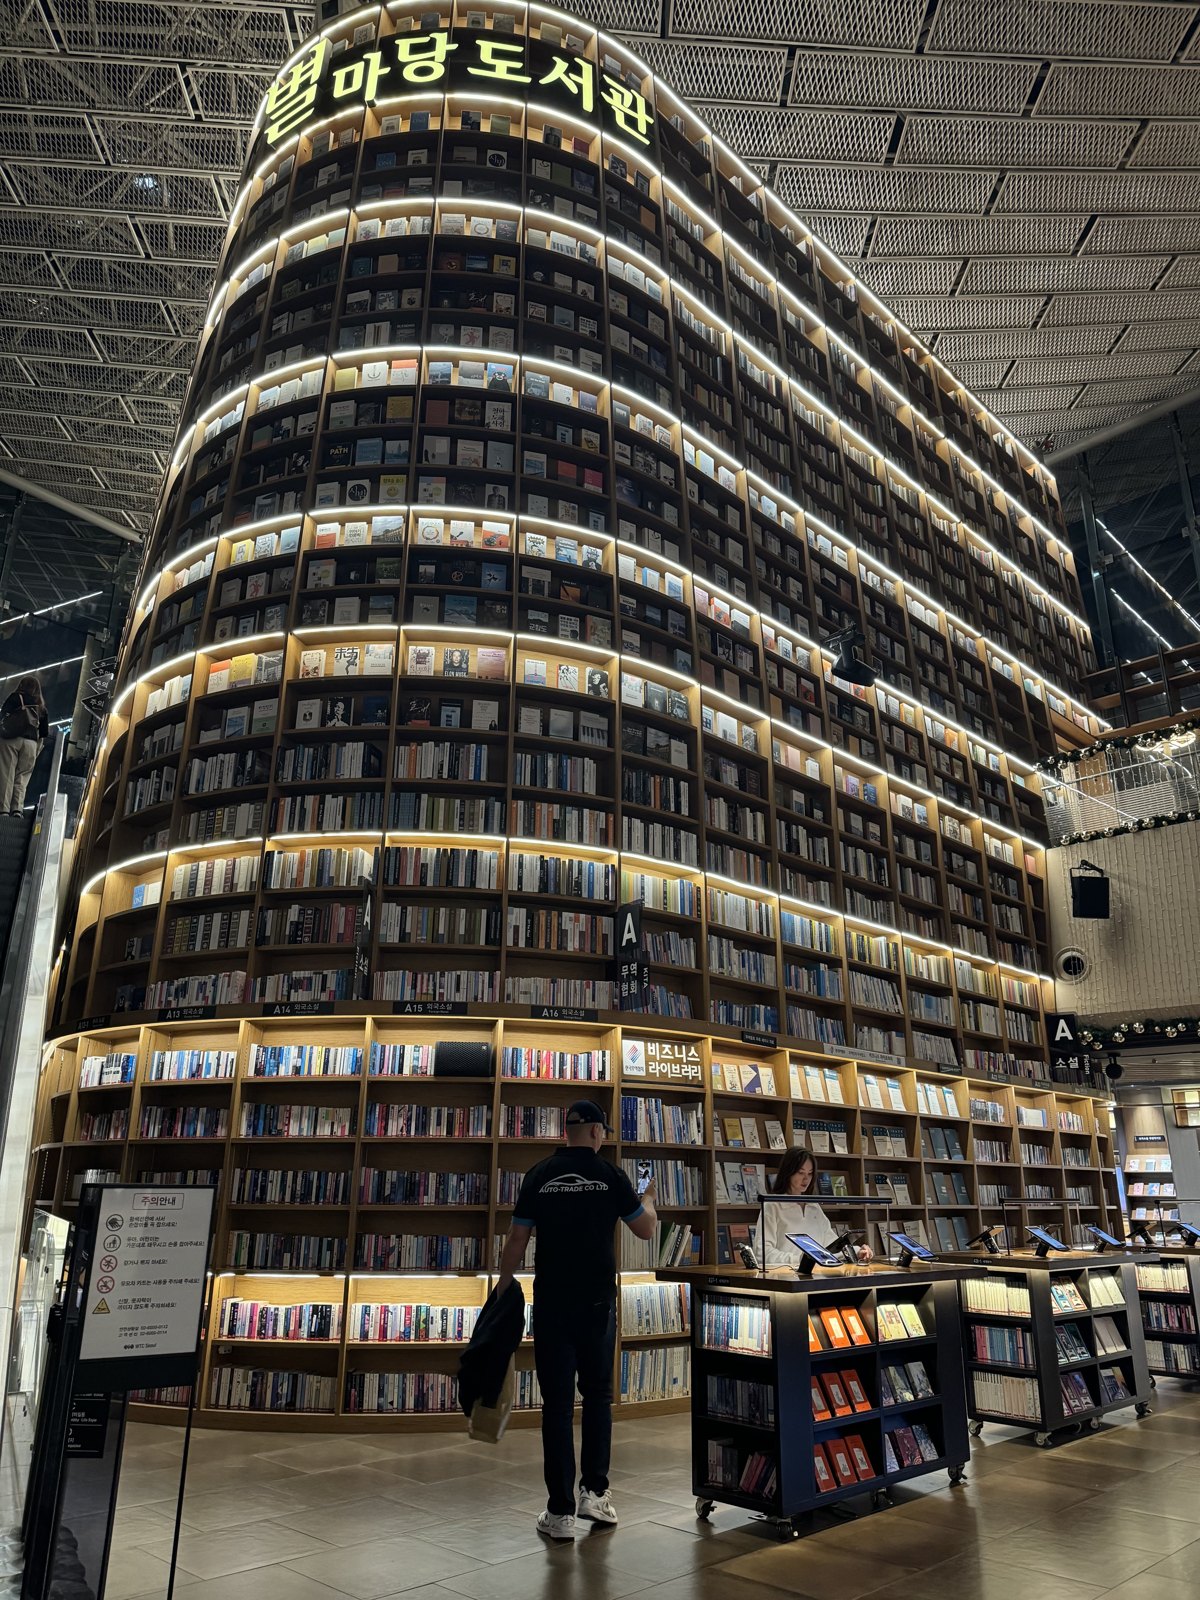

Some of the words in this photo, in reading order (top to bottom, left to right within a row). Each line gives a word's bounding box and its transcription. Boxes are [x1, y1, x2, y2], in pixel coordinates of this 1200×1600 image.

[363, 893, 371, 931] A
[621, 912, 637, 947] A
[166, 1010, 181, 1019] A13
[273, 1004, 291, 1014] A14
[404, 1003, 423, 1013] A15
[426, 1003, 452, 1011] 외국소설
[542, 1008, 559, 1018] A16
[561, 1008, 585, 1017] 외국소설
[1054, 1019, 1074, 1041] A
[647, 1042, 701, 1063] 비즈니스
[1055, 1056, 1079, 1069] 소설
[1083, 1054, 1091, 1075] Fiction
[648, 1062, 702, 1081] 라이브러리
[595, 1183, 609, 1191] LTD
[141, 1196, 176, 1206] 주의안내
